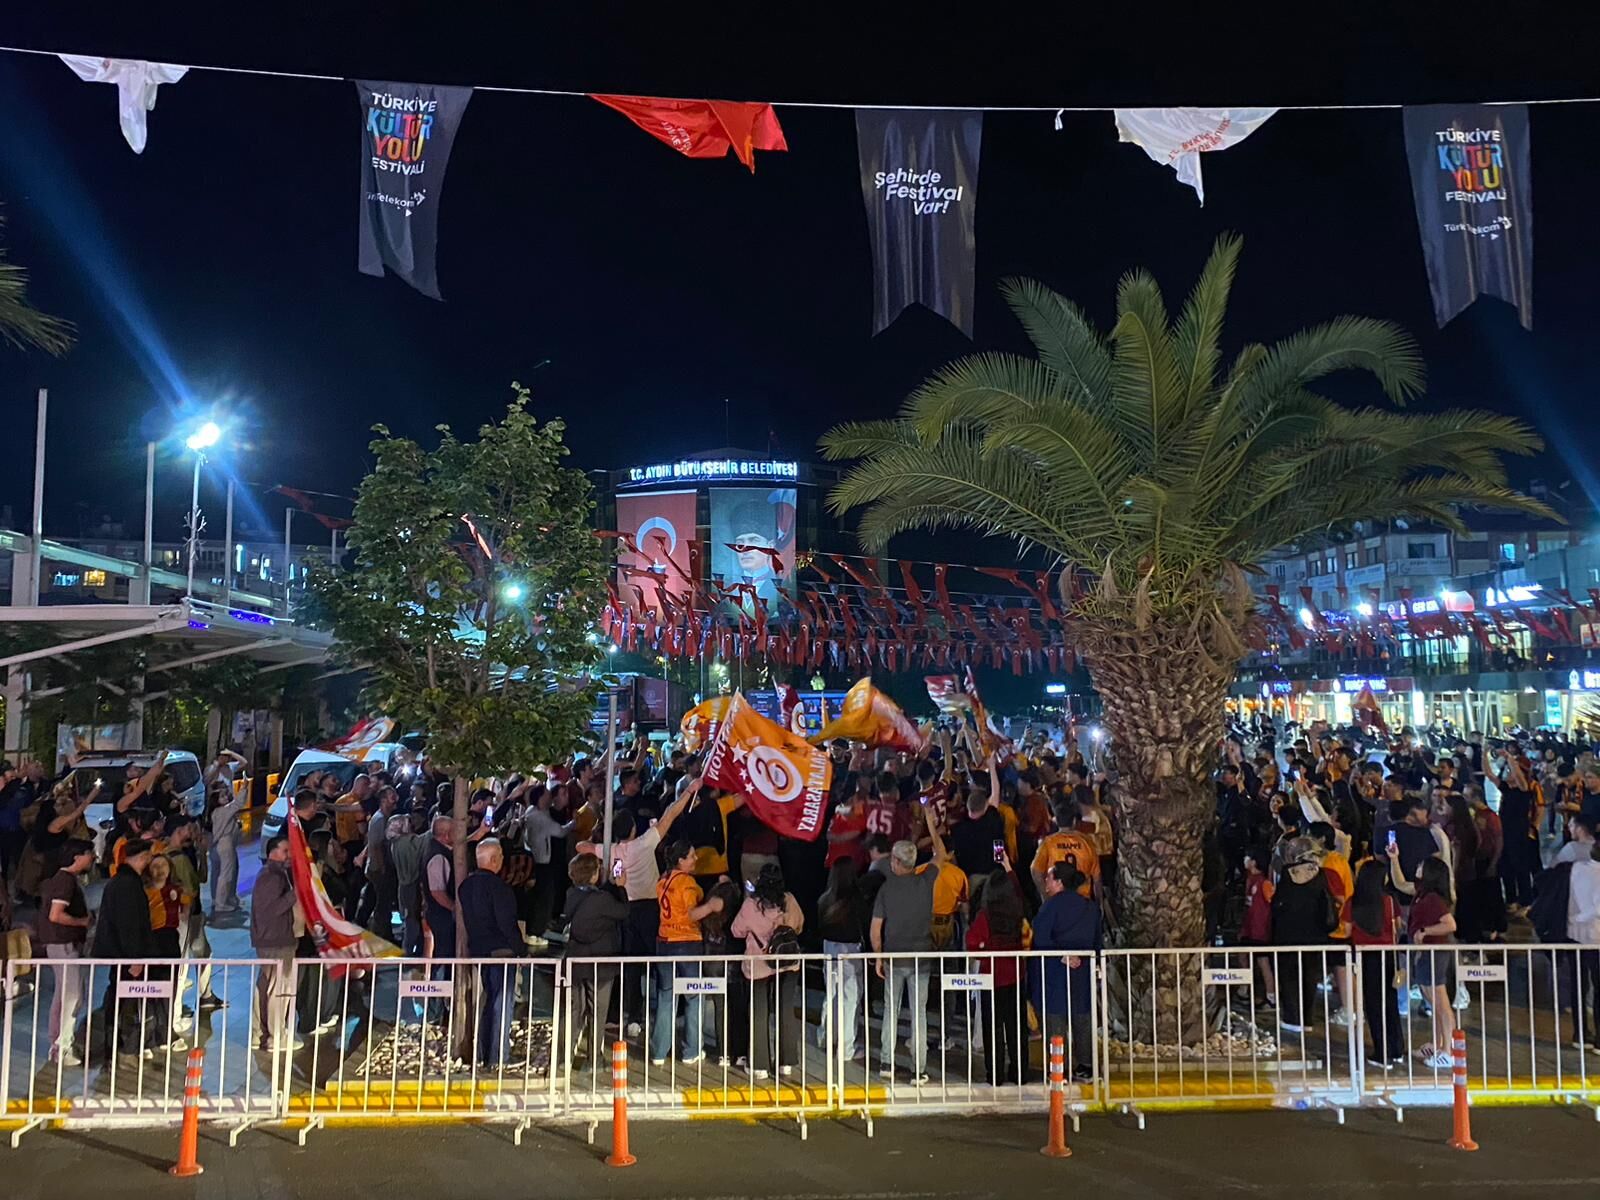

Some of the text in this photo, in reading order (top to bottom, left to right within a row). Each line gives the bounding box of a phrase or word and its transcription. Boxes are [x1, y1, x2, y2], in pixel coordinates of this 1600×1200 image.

[371, 92, 438, 112] TÜRKİYE
[366, 107, 433, 139] KÜLTÜR
[1435, 127, 1501, 143] TÜRKİYE
[374, 135, 425, 162] YOLU
[1437, 143, 1504, 172] KÜLTÜR
[371, 156, 425, 176] ESTİVALİ
[874, 167, 942, 189] Şehirde
[1451, 166, 1500, 192] YOLU
[885, 183, 964, 202] Festival
[913, 200, 950, 216] Var!
[645, 464, 672, 479] AYDIN
[673, 459, 739, 477] BÜYÜKŞEHİR
[740, 460, 798, 476] BELEDİYESİ
[866, 808, 893, 835] 45
[951, 978, 977, 986] POLİS
[1211, 972, 1238, 981] POLİS
[1467, 969, 1492, 977] POLİS
[128, 984, 156, 993] POLİS
[409, 984, 437, 992] POLİS
[686, 982, 713, 991] POLİS
